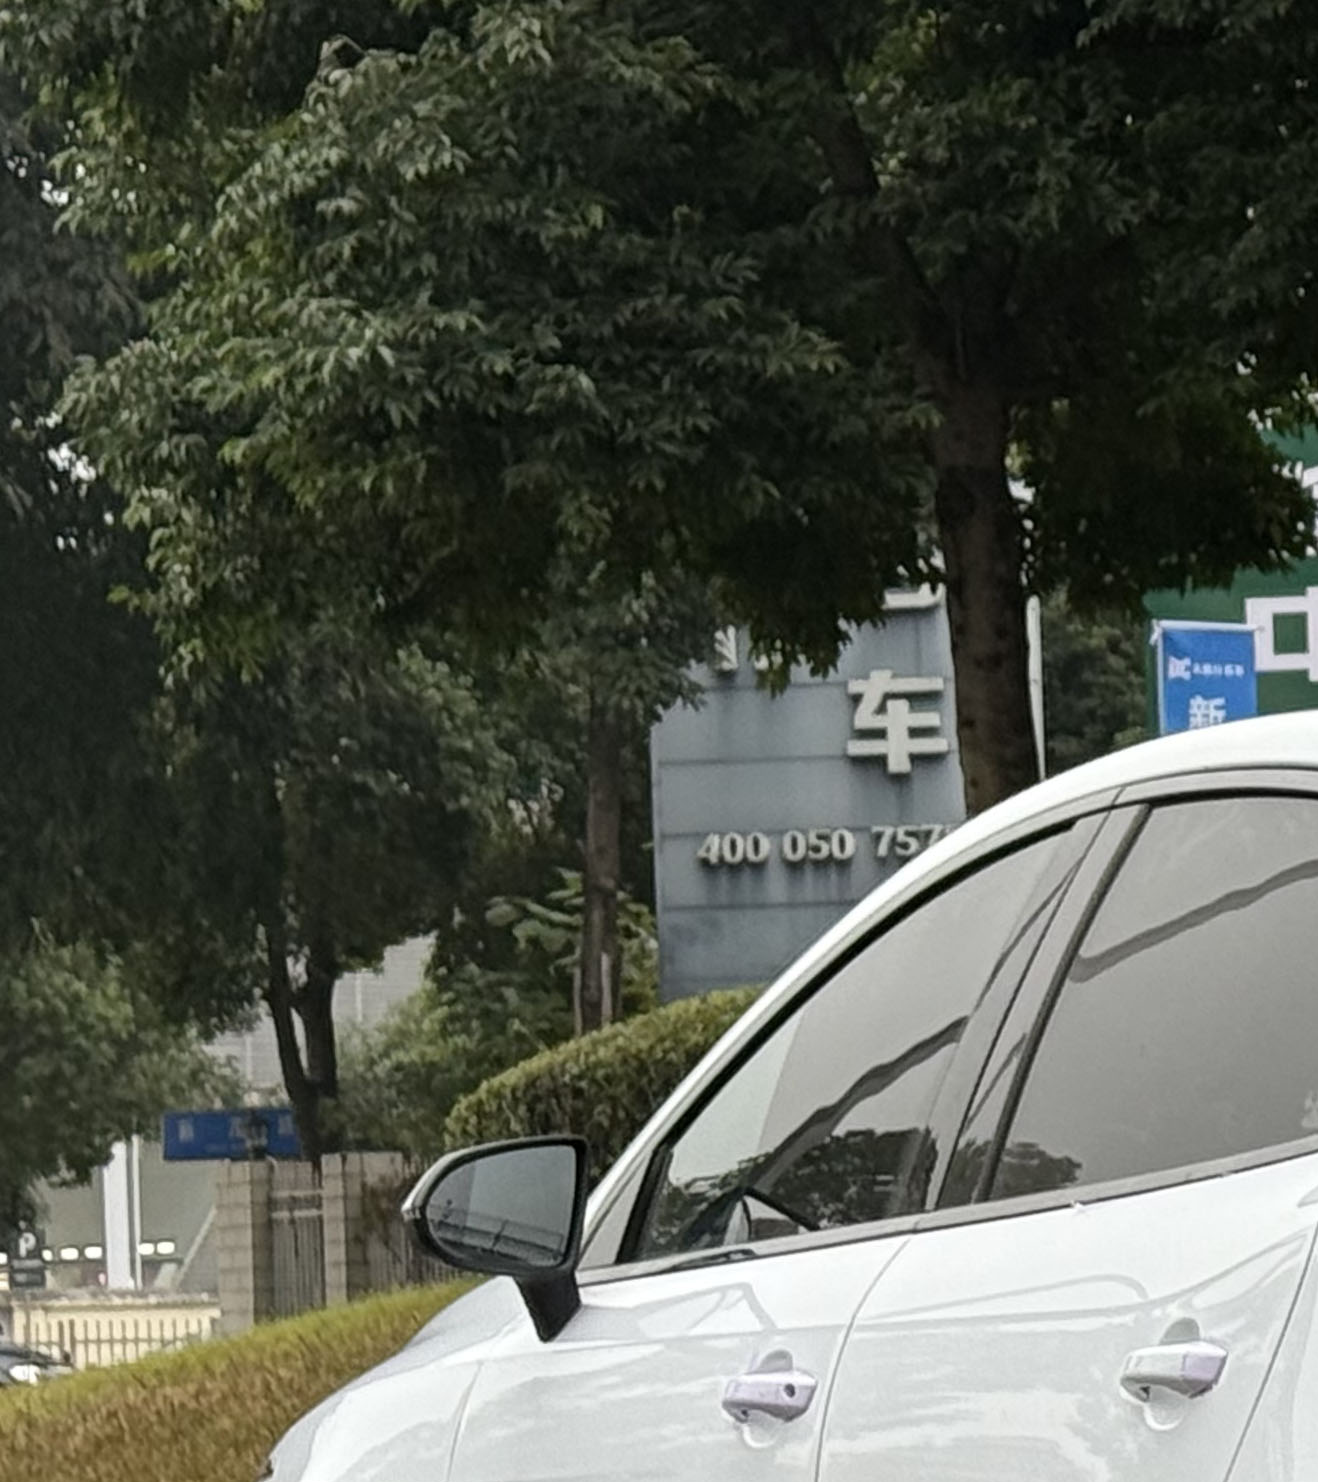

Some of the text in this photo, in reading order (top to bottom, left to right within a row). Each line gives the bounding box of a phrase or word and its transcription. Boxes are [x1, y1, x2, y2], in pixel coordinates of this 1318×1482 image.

[697, 824, 958, 865] 400 050 757
